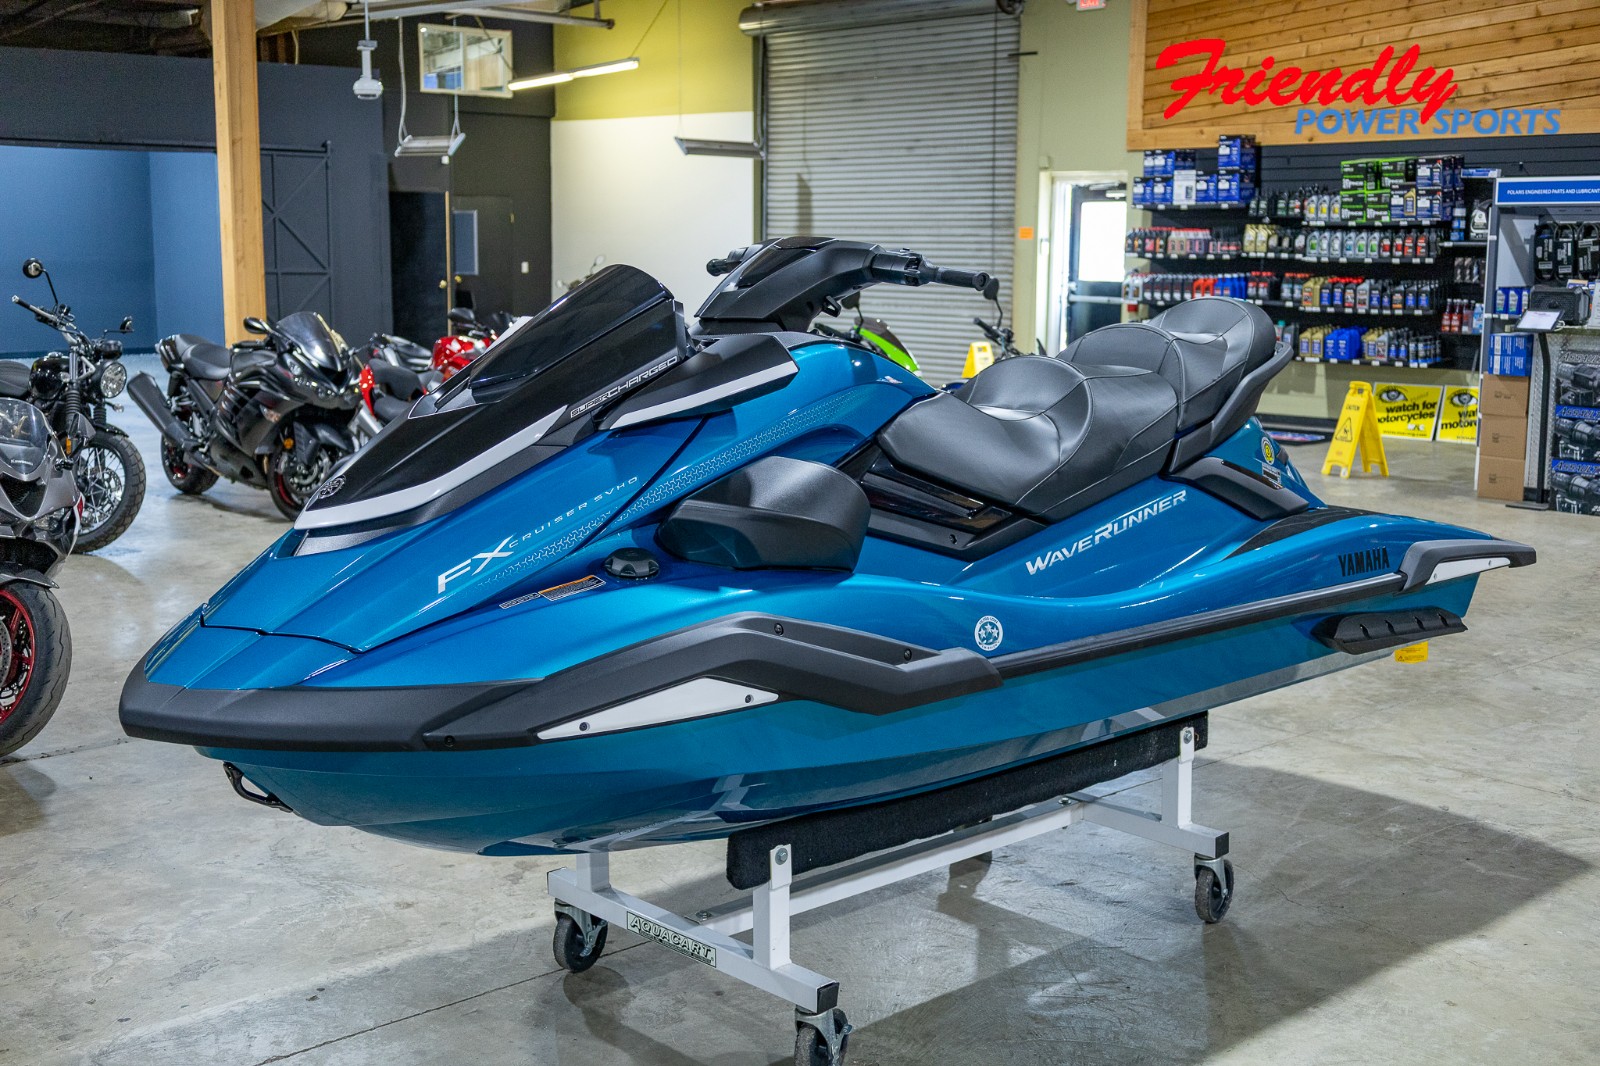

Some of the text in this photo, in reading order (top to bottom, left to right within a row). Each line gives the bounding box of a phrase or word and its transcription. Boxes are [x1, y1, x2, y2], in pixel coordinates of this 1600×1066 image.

[570, 355, 678, 418] SUPERCHARGED
[1386, 400, 1437, 413] watch for
[438, 532, 517, 594] FX
[509, 502, 588, 548] CRUISER
[594, 476, 638, 502] SVHO
[1338, 546, 1390, 577] YAMAHA
[630, 916, 711, 958] AQUACART
